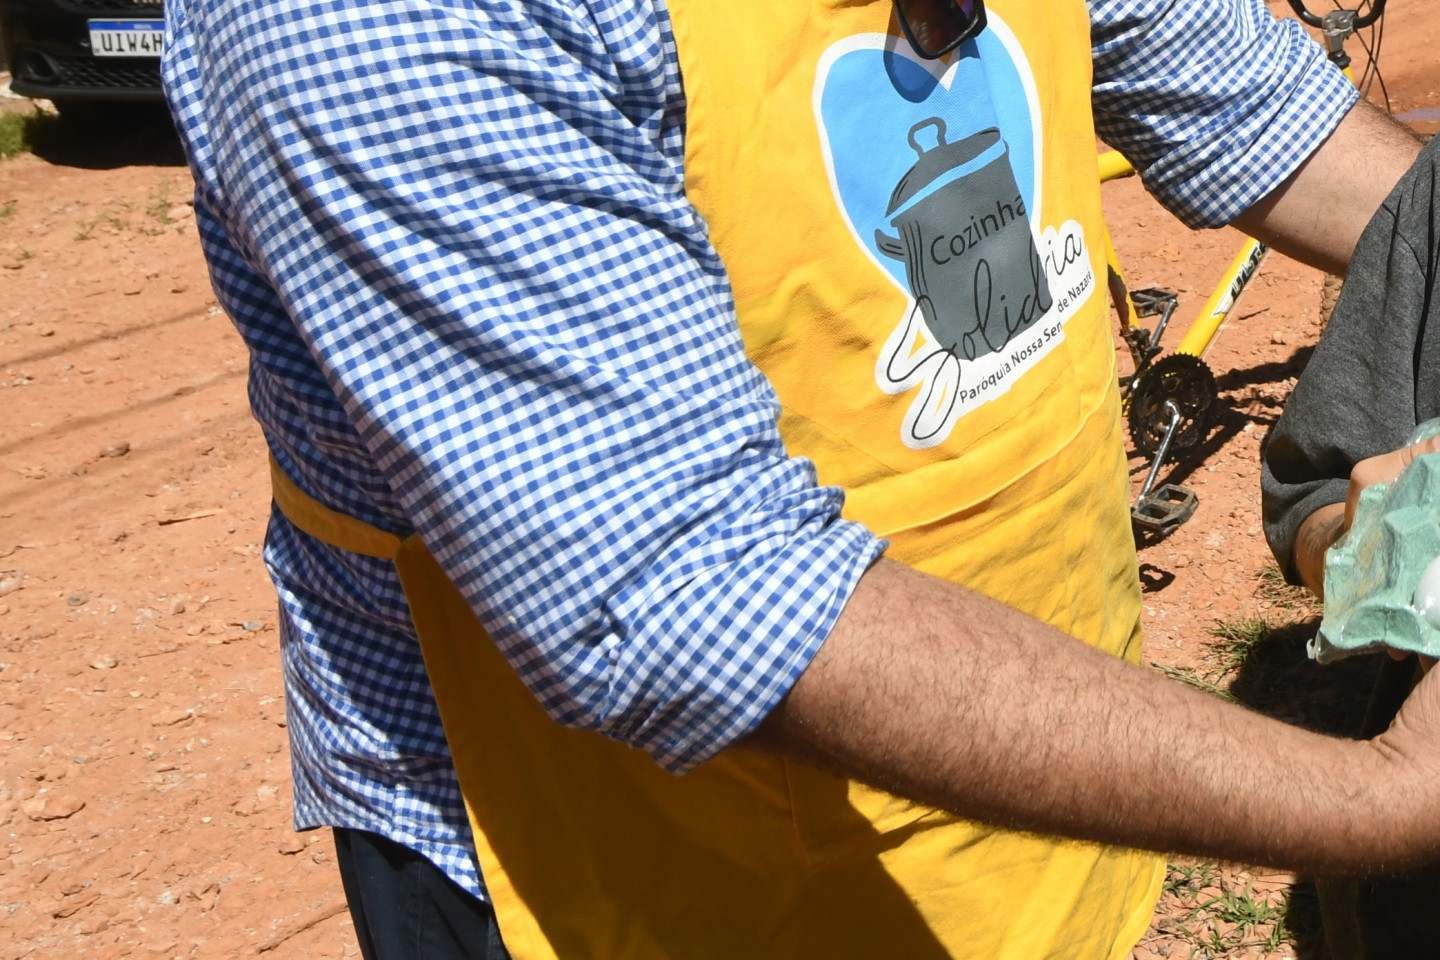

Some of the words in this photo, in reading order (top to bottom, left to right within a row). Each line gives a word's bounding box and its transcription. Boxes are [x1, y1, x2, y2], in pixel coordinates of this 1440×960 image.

[930, 194, 1026, 265] Cozinha
[959, 363, 1012, 404] Paróquia
[1010, 337, 1044, 367] Nossa
[1057, 298, 1070, 313] de
